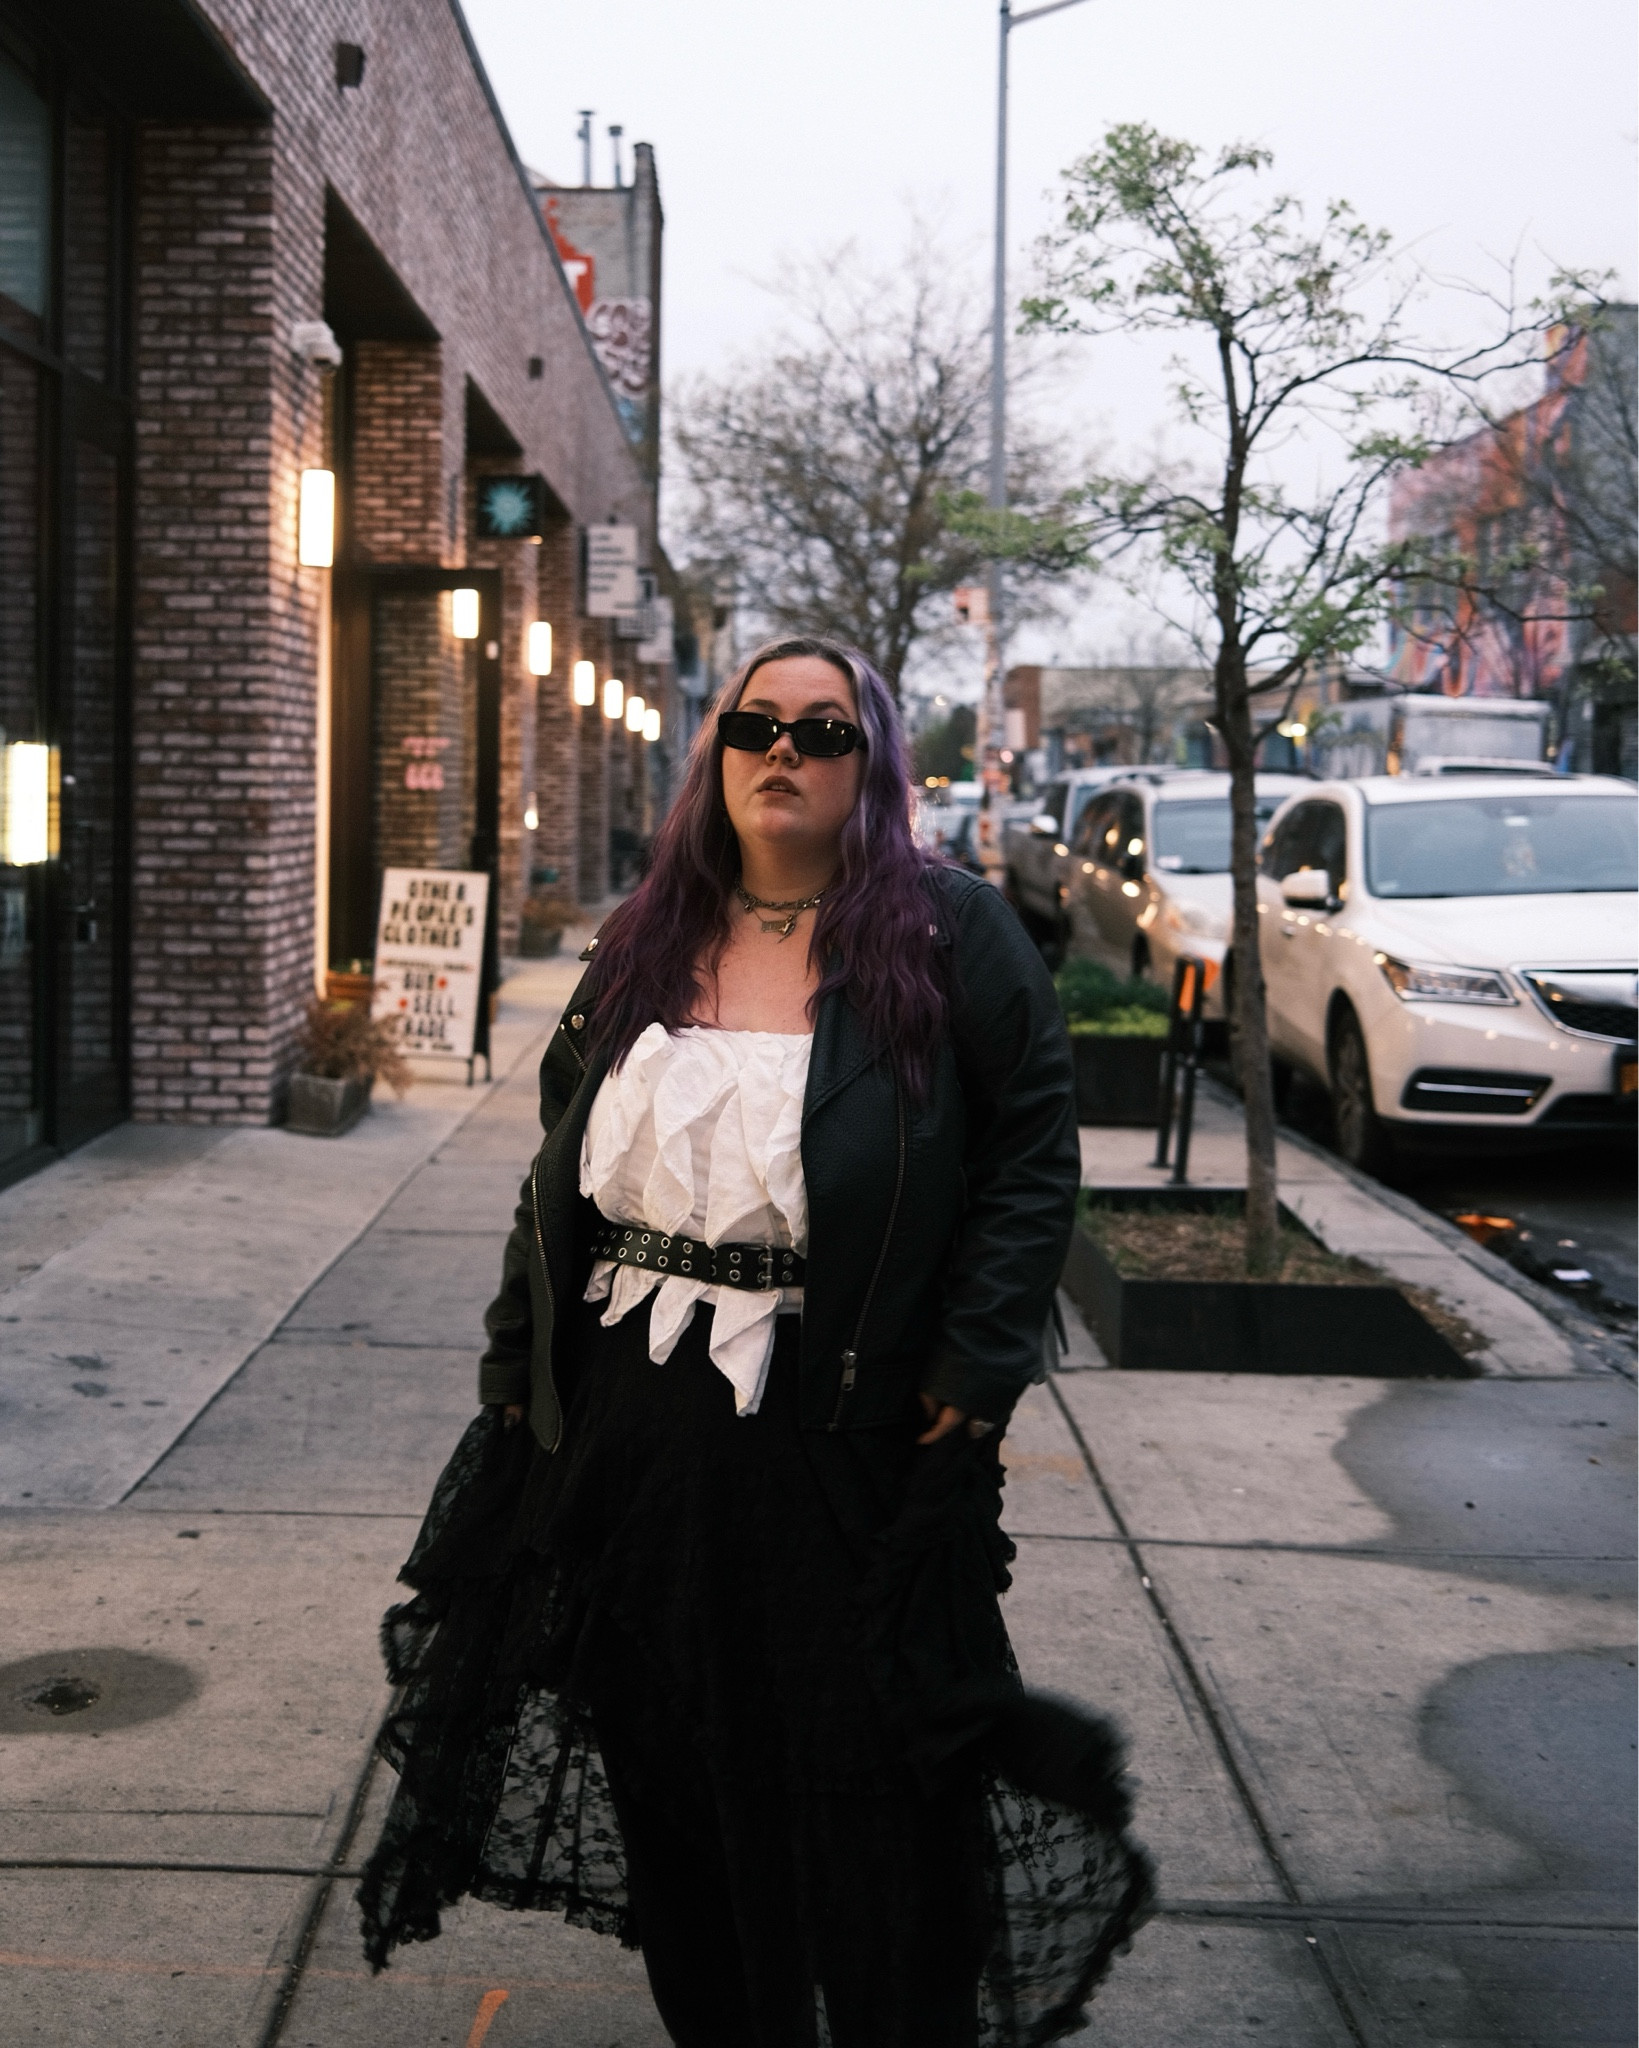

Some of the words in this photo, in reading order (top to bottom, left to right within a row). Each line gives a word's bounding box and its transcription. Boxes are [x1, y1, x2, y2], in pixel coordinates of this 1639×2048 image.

[408, 879, 465, 901] OTHER
[383, 923, 461, 947] CLOTHES
[414, 996, 455, 1016] SELL
